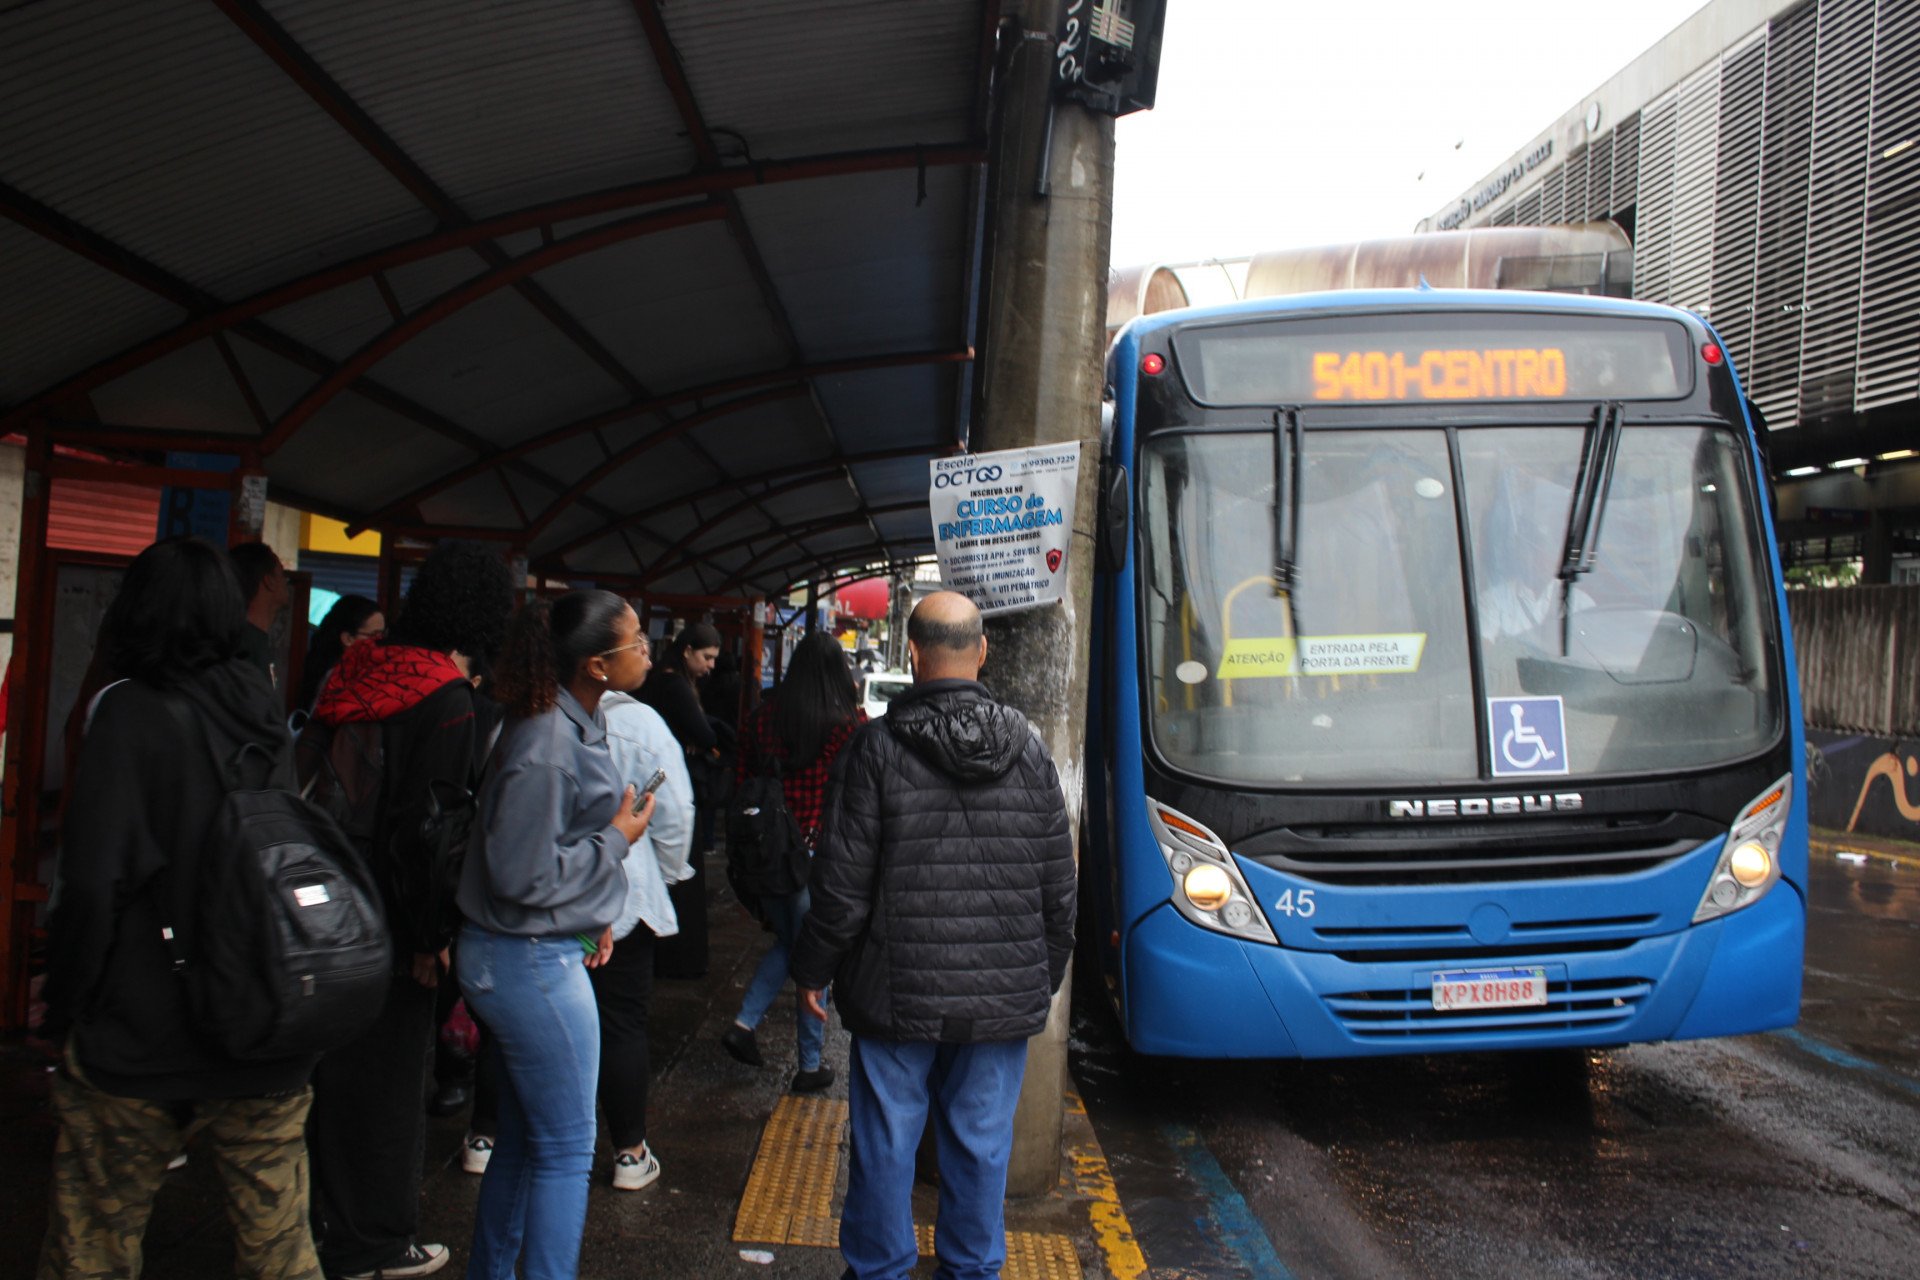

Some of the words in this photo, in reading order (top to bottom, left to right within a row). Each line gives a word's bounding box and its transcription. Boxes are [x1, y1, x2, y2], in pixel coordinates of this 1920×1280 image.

[1312, 348, 1567, 399] 5401-CENTRO
[936, 458, 974, 470] Escola
[970, 486, 1013, 498] INSCREVA-SE
[956, 495, 1022, 519] CURSO
[1025, 493, 1044, 510] de
[938, 508, 1062, 541] ENFERMAGEM
[980, 538, 991, 546] UM
[952, 573, 984, 586] VACINAÇÃO
[992, 567, 1035, 580] IMUNIZAÇÃO
[1010, 578, 1050, 592] PEDIÁTRICO
[1310, 643, 1365, 655] ENTRADA
[1368, 642, 1399, 653] PELA
[1227, 652, 1284, 664] ATENÇÃO
[1301, 658, 1340, 668] PORTA
[1344, 657, 1360, 667] DA
[1363, 654, 1409, 666] FRENTE
[1389, 793, 1583, 817] NEOBUS
[1275, 888, 1316, 918] 45
[1442, 980, 1533, 1004] KPX8H88
